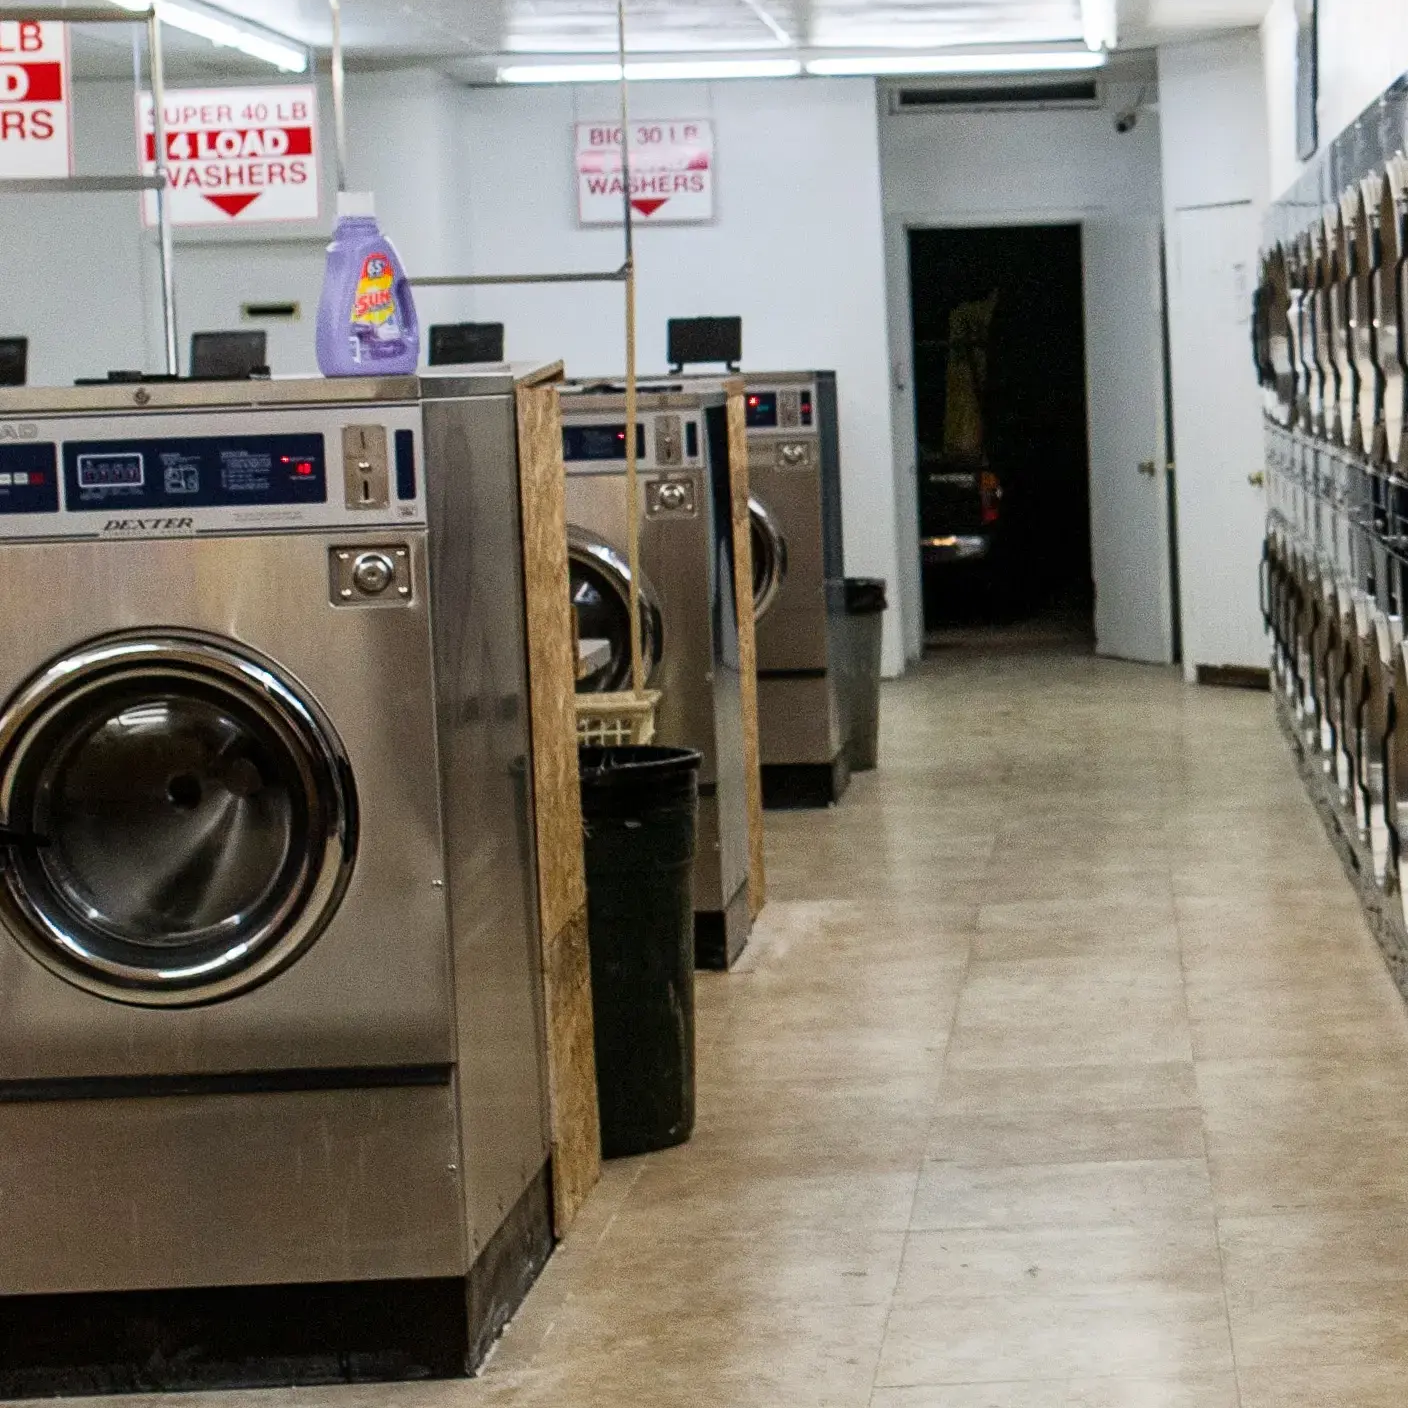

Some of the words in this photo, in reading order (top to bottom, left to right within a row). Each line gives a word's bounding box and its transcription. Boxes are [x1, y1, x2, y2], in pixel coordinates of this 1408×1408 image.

[241, 104, 268, 122] 40
[277, 101, 308, 121] LB
[169, 132, 191, 160] 4
[197, 129, 290, 159] LOAD
[637, 126, 663, 145] 30
[588, 175, 705, 195] WASHERS
[104, 518, 193, 531] DEXTER
